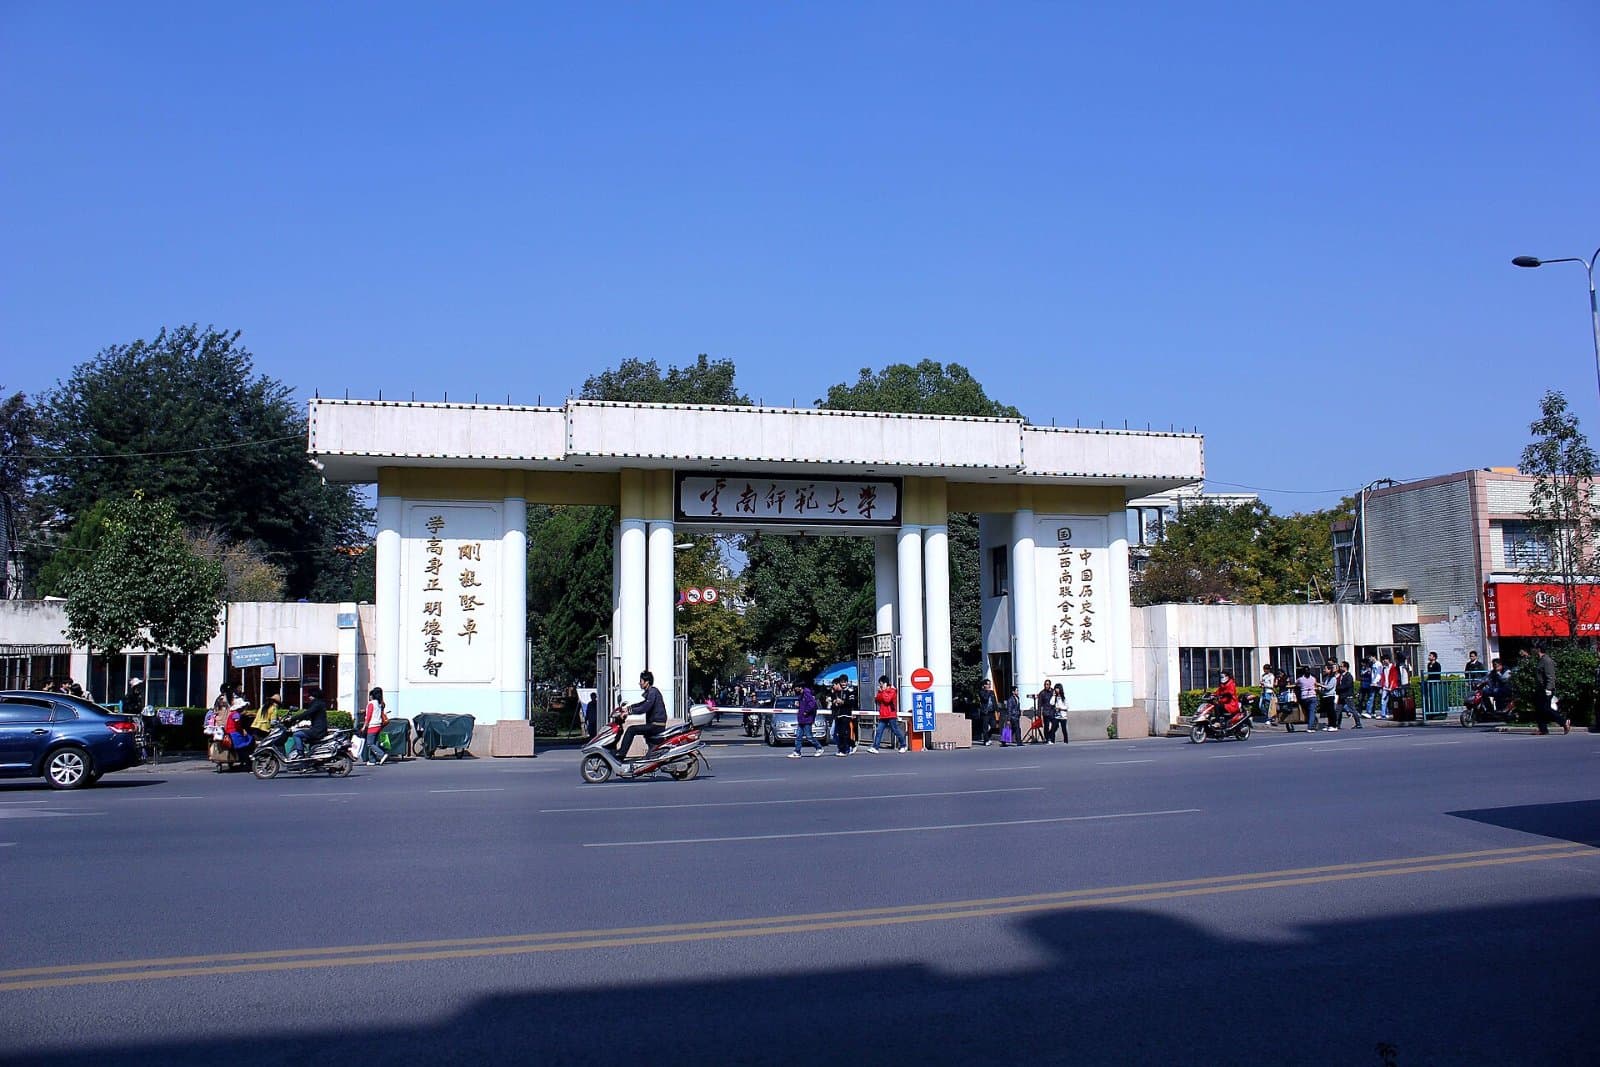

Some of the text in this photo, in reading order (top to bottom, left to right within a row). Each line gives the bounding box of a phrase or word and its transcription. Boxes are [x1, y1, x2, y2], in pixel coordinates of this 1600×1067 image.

[706, 590, 713, 600] 5
[1057, 527, 1076, 671] 国立西南联合大学旧址
[1078, 549, 1096, 644] 中国历史名校
